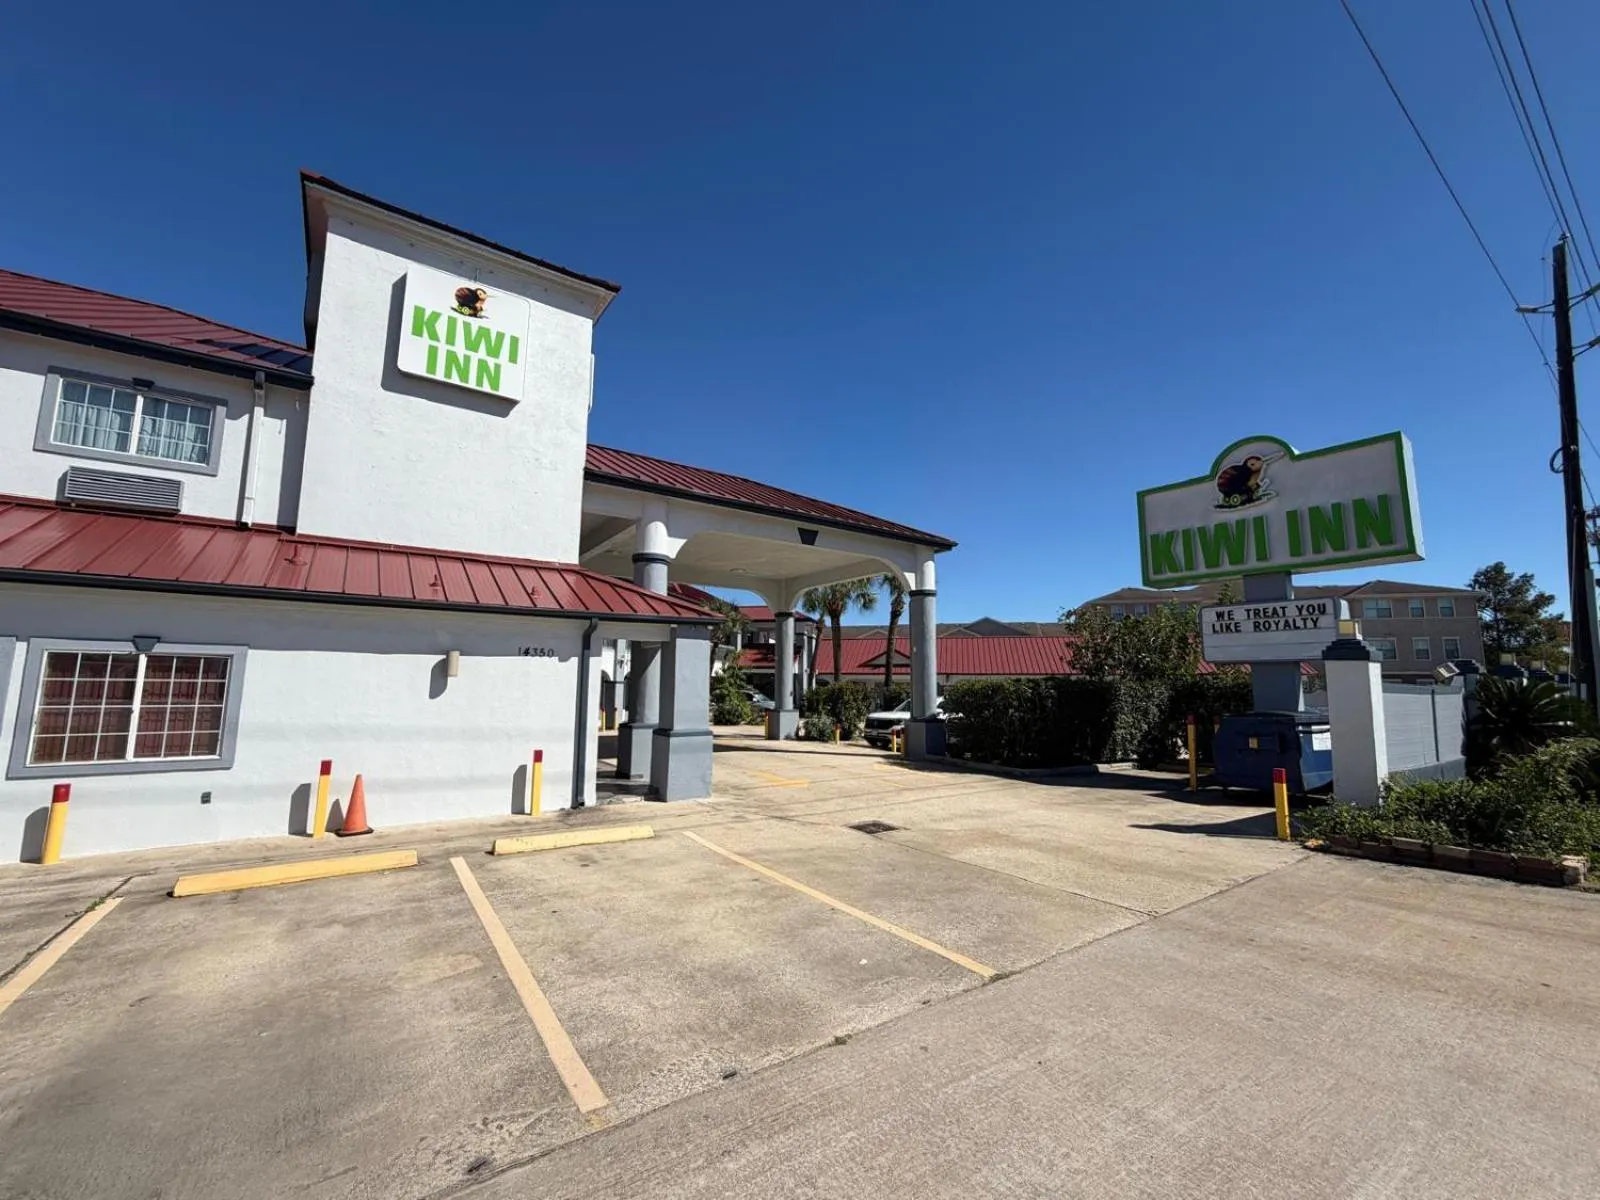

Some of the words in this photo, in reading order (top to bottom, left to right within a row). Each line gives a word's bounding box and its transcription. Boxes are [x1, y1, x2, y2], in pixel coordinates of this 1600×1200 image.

[411, 305, 520, 365] KIWI
[426, 344, 502, 392] INN
[1150, 515, 1268, 575] KIWI
[1286, 494, 1395, 558] INN
[1212, 622, 1242, 634] LIKE
[1253, 617, 1319, 632] ROYALTY
[1216, 610, 1235, 621] WE
[1245, 606, 1288, 620] TREAT
[1296, 603, 1327, 617] YOU
[518, 646, 554, 658] 14350
